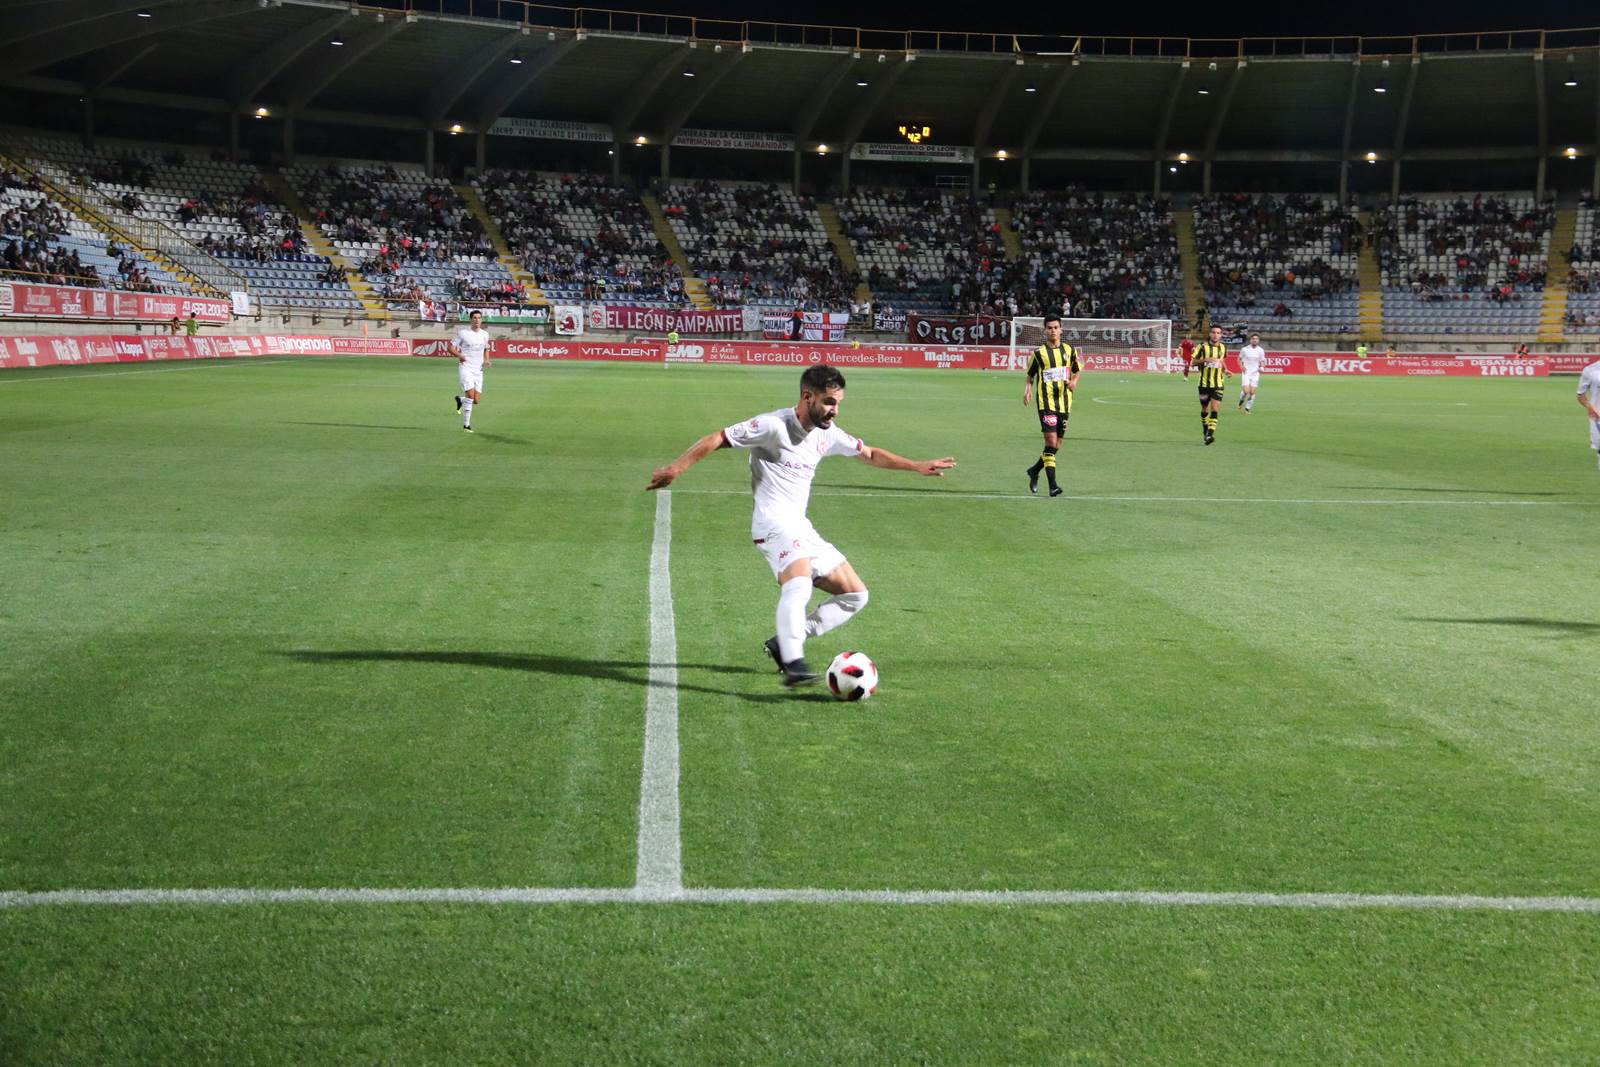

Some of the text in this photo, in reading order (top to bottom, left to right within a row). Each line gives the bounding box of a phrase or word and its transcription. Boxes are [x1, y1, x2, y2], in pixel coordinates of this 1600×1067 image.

[898, 125, 930, 137] 4 0
[677, 137, 720, 146] PATRIMONIO
[744, 141, 787, 149] HUMANIDAD
[907, 133, 921, 143] 42
[606, 309, 742, 333] EL LEÓN RAMPANTE
[582, 348, 659, 357] VITALDENT
[746, 351, 803, 362] Lercauto
[924, 352, 964, 362] Mahou
[826, 353, 902, 364] Mercedes-Benz
[1086, 355, 1140, 365] ASPIRE
[1333, 360, 1372, 373] KFC
[1480, 365, 1534, 376] ZAPICO
